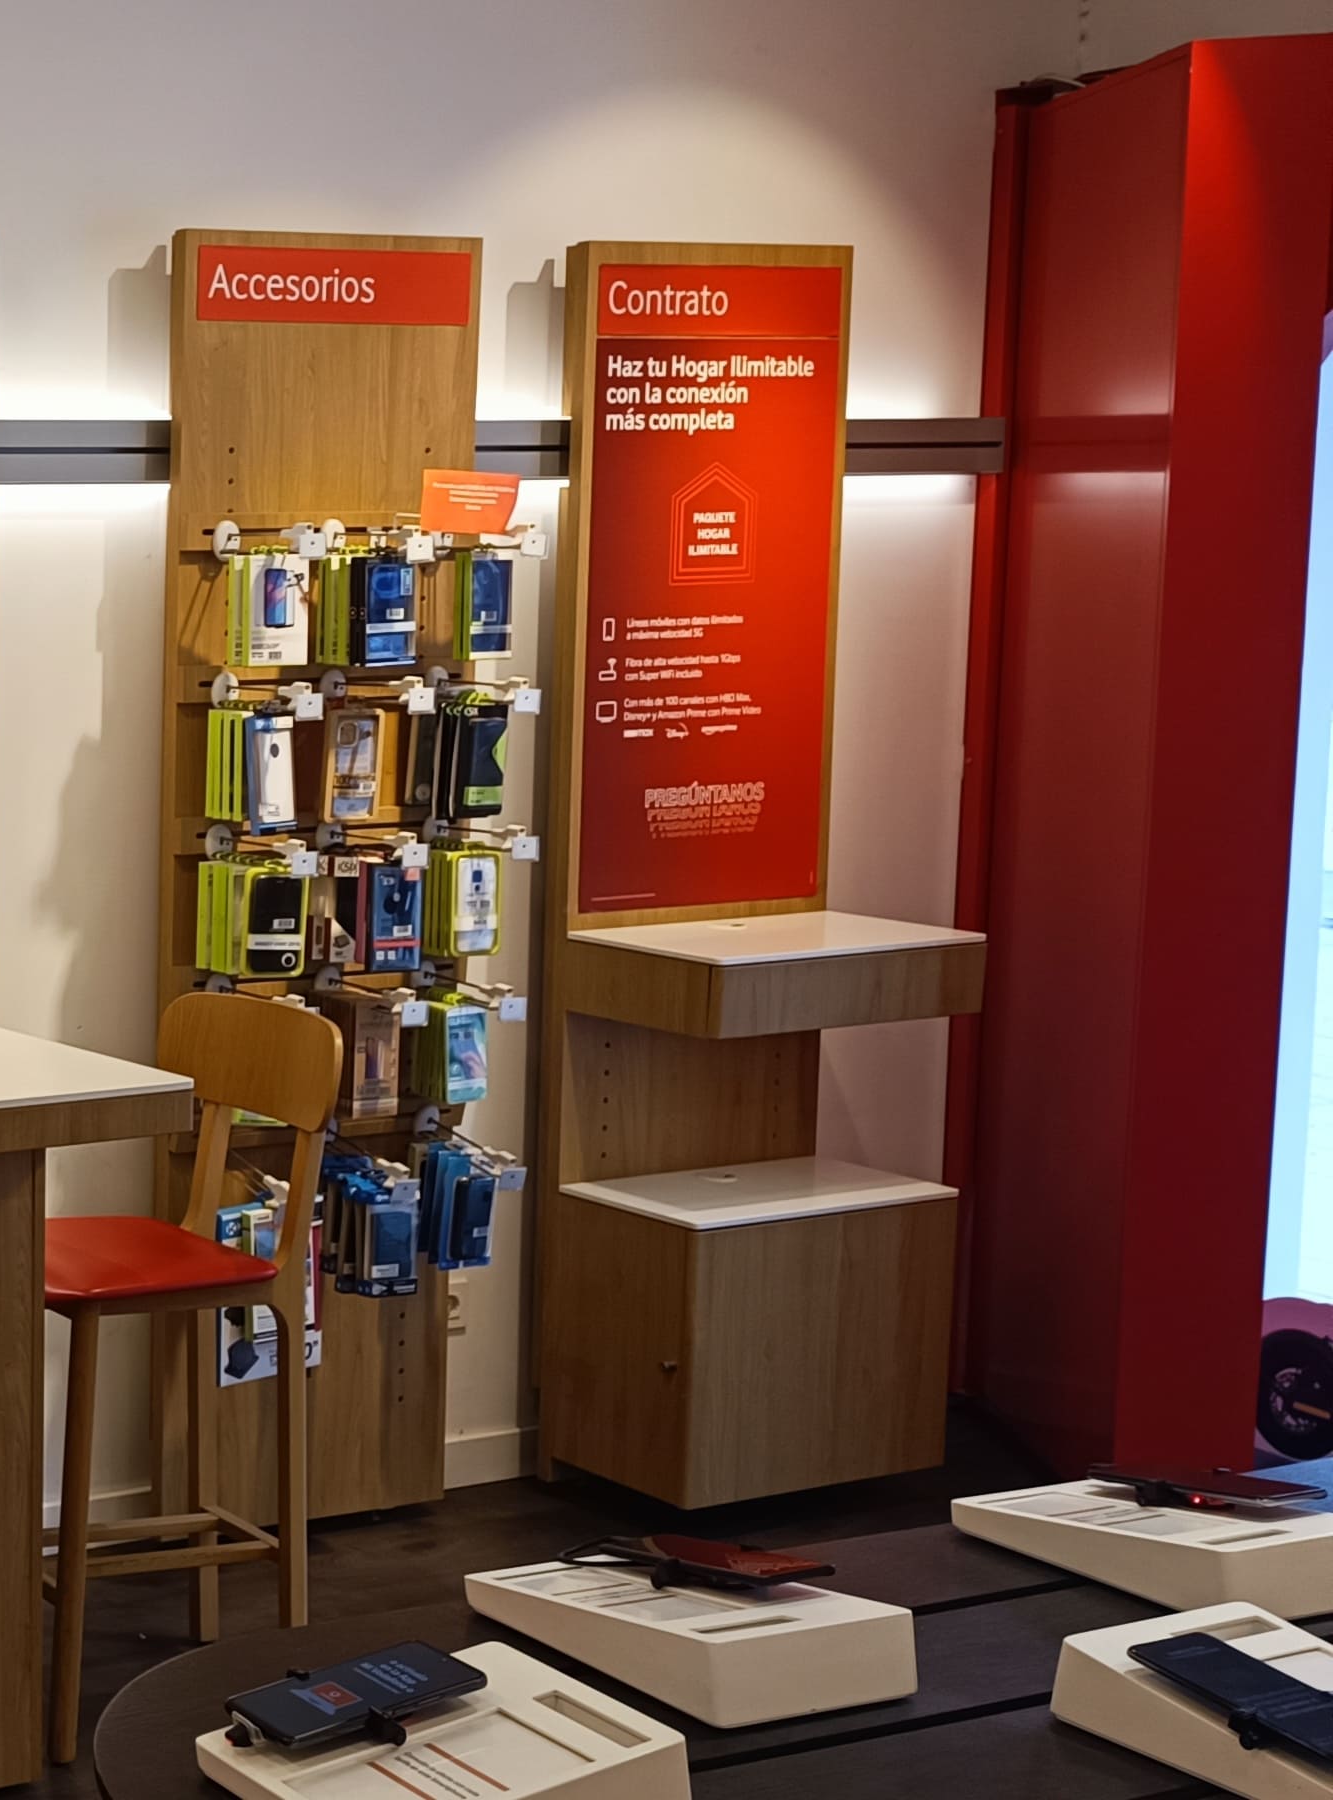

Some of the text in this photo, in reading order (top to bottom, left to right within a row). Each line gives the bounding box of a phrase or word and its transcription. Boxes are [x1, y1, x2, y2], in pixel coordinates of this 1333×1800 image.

[208, 263, 376, 303] Accesorios
[608, 280, 729, 316] Contrato
[607, 355, 815, 382] Haz tu Hogar Ilimitable
[606, 381, 748, 404] con la conexión
[605, 408, 734, 435] más completa
[693, 511, 736, 524] PAQUETE
[697, 528, 730, 540] HOGAR
[644, 780, 765, 808] PREGÚNTANOS
